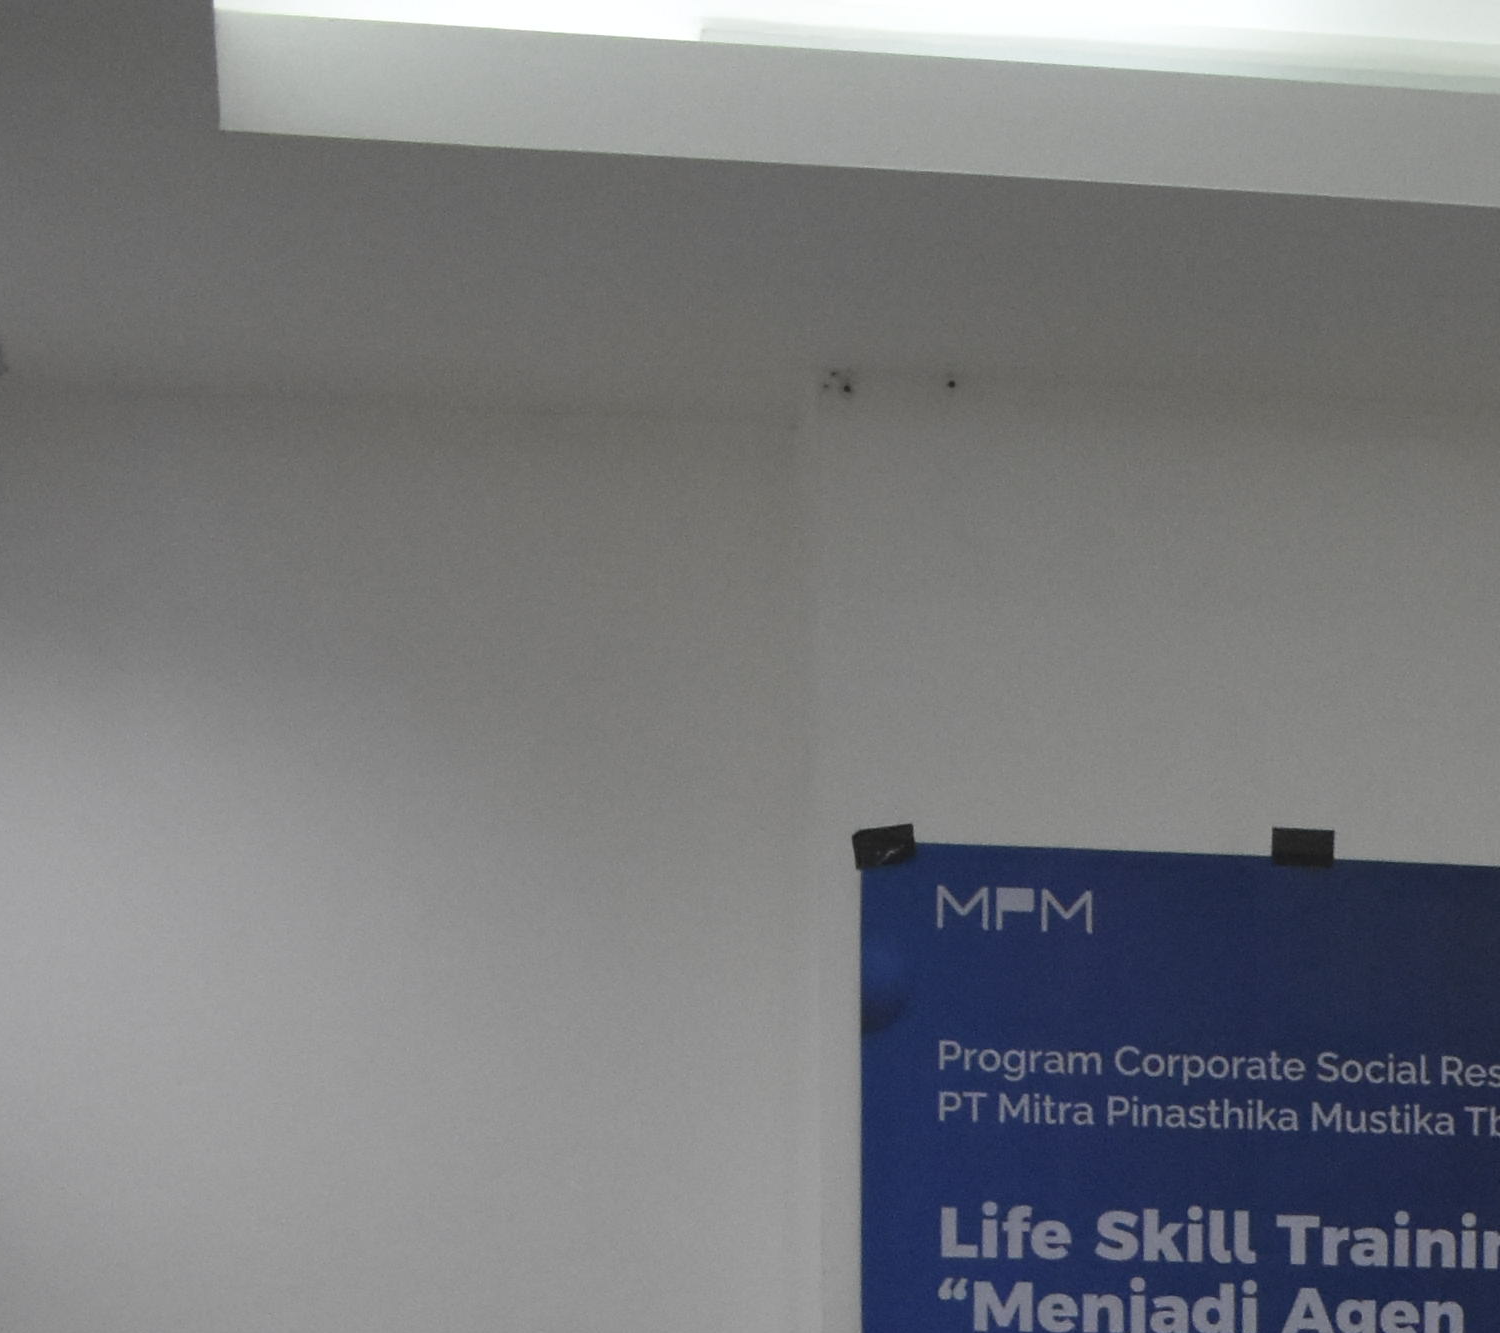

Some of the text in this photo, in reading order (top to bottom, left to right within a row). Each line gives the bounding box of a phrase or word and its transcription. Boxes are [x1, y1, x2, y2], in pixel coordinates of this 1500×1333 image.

[936, 884, 1093, 934] MPM
[938, 1039, 1102, 1082] Program
[1114, 1045, 1306, 1086] Corporate
[1317, 1051, 1431, 1086] Social
[938, 1090, 988, 1122] PT
[998, 1092, 1095, 1126] Mitra
[1107, 1095, 1299, 1132] Pinasthika
[1311, 1101, 1455, 1136] Mustika
[940, 1201, 1072, 1260] Life
[1095, 1205, 1257, 1264] Skill
